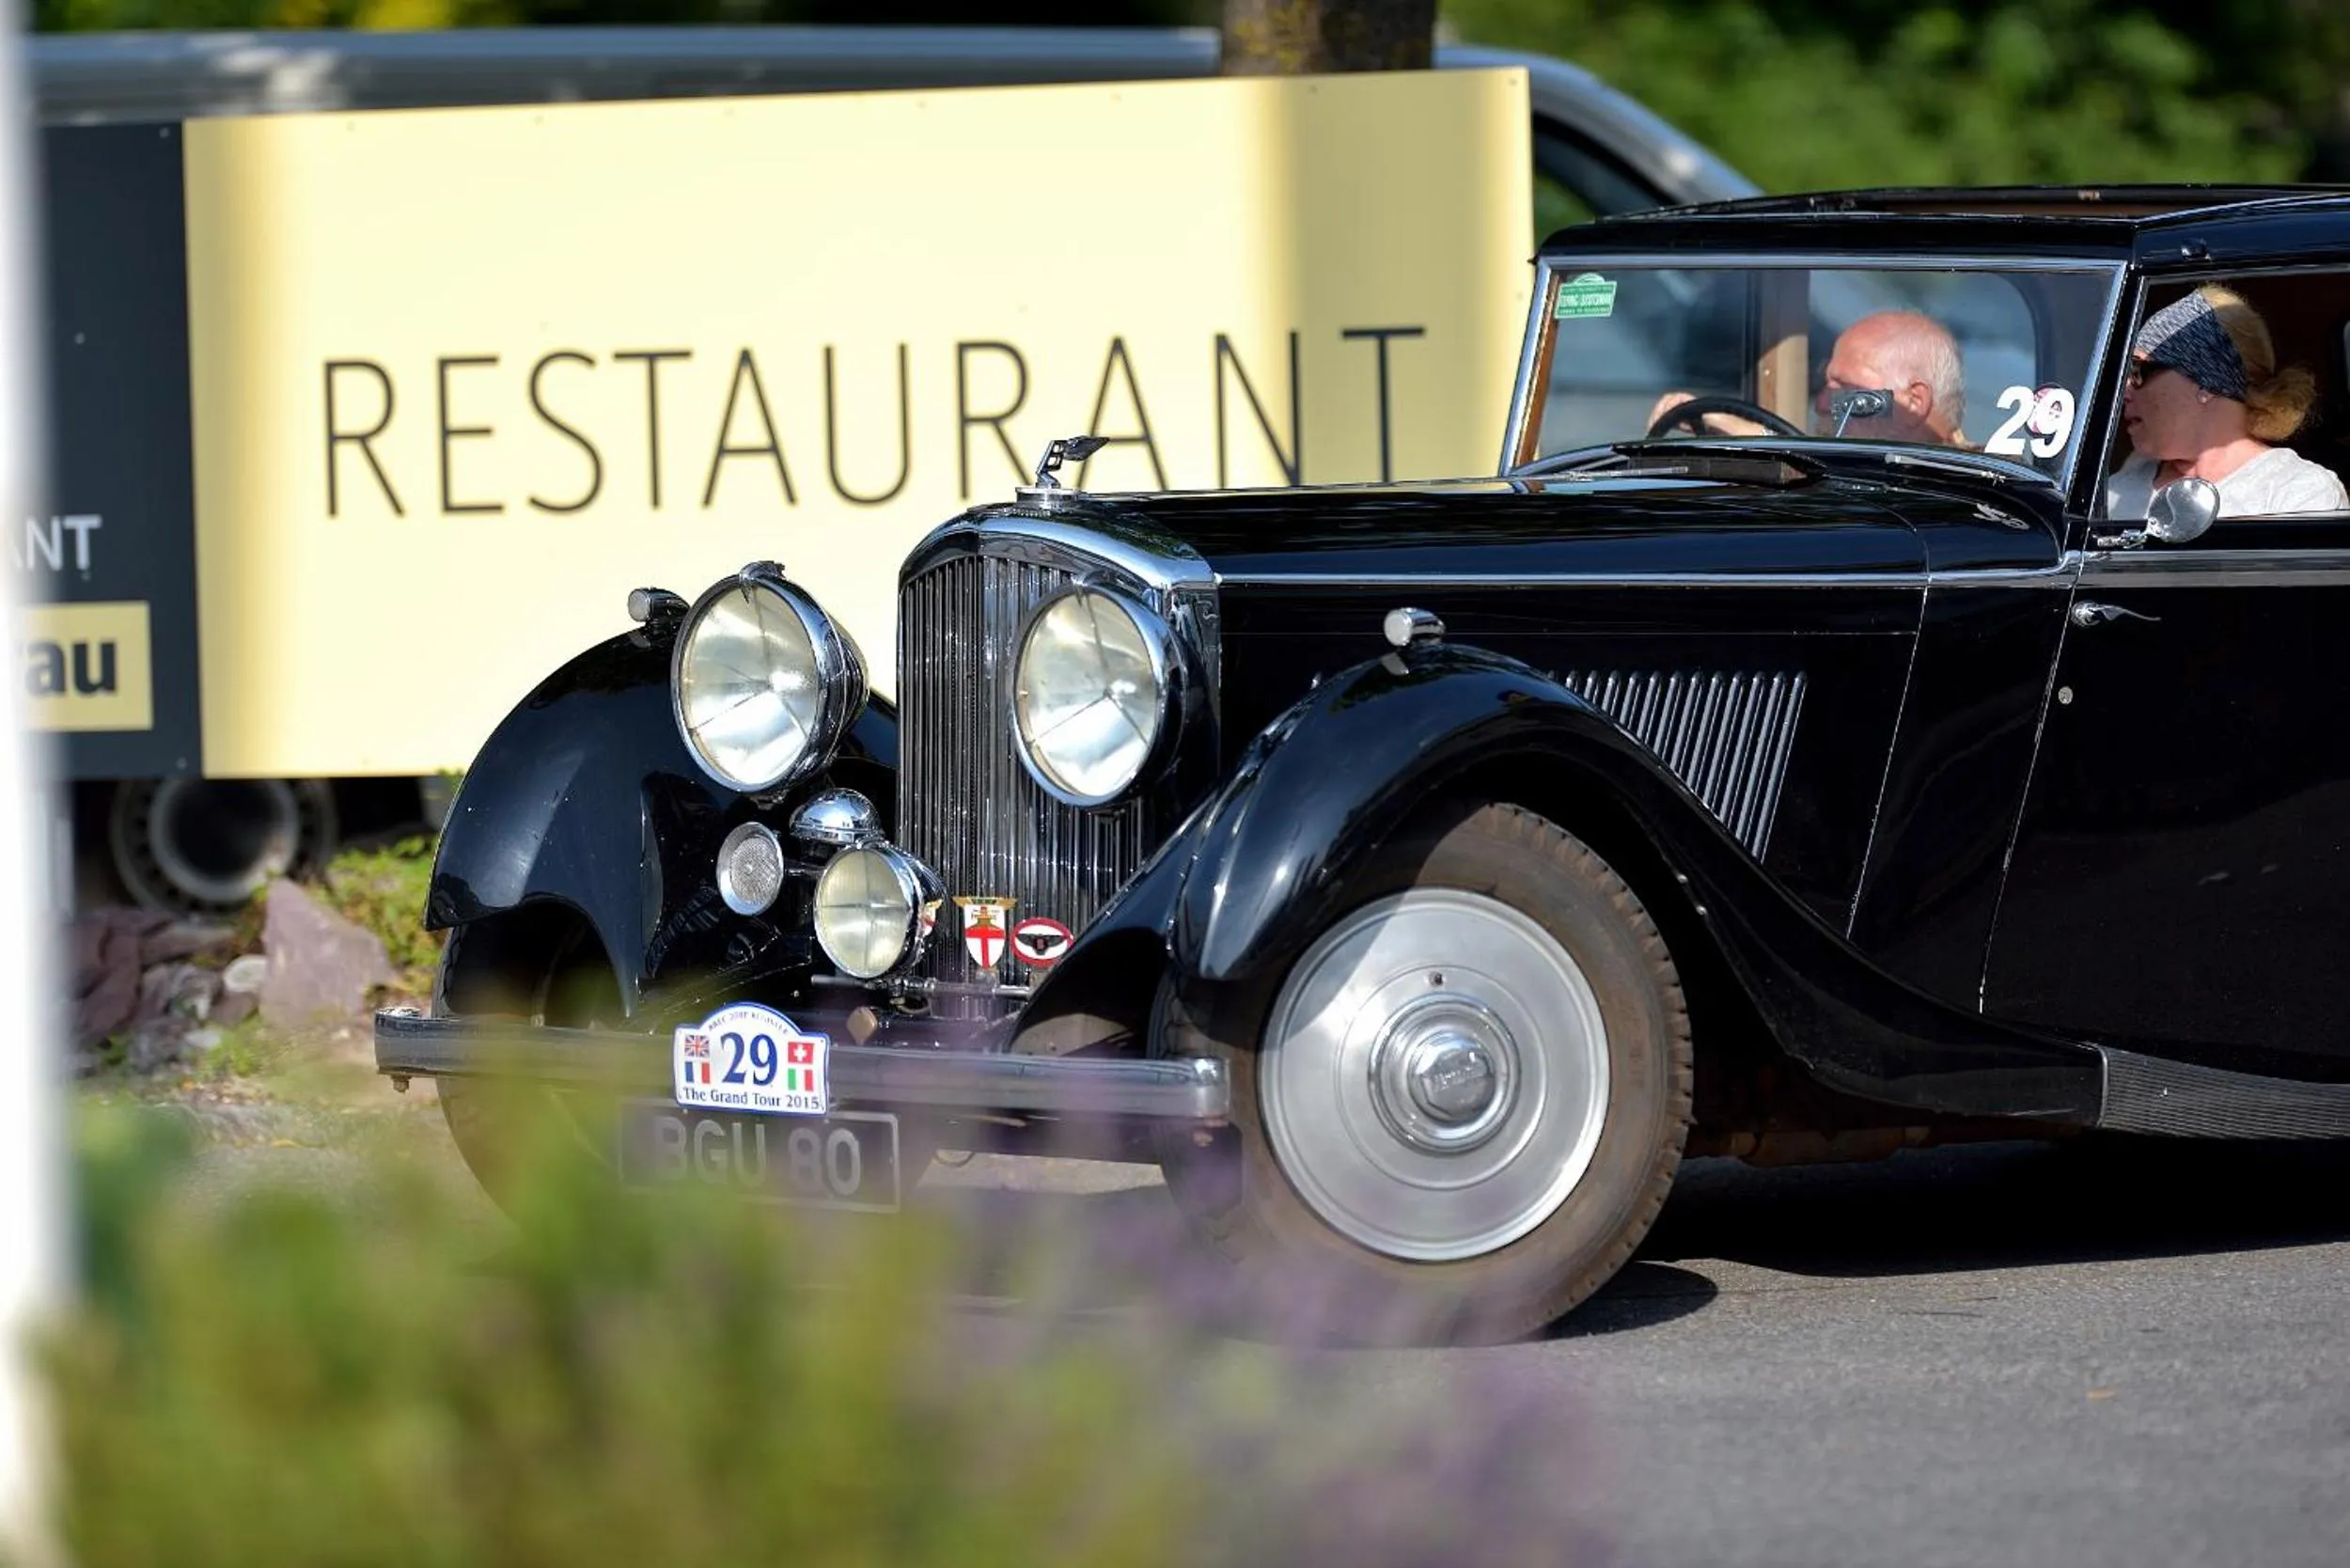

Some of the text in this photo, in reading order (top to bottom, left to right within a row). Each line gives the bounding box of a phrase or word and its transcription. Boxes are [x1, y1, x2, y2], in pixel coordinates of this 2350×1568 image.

[324, 326, 1427, 519] RESTAURANT
[1984, 385, 2076, 459] 29
[14, 514, 102, 572] NT
[17, 639, 118, 698] au
[720, 1032, 778, 1087] 29
[683, 1087, 820, 1110] The Grand Tour 2015
[654, 1116, 862, 1196] BGU 80
